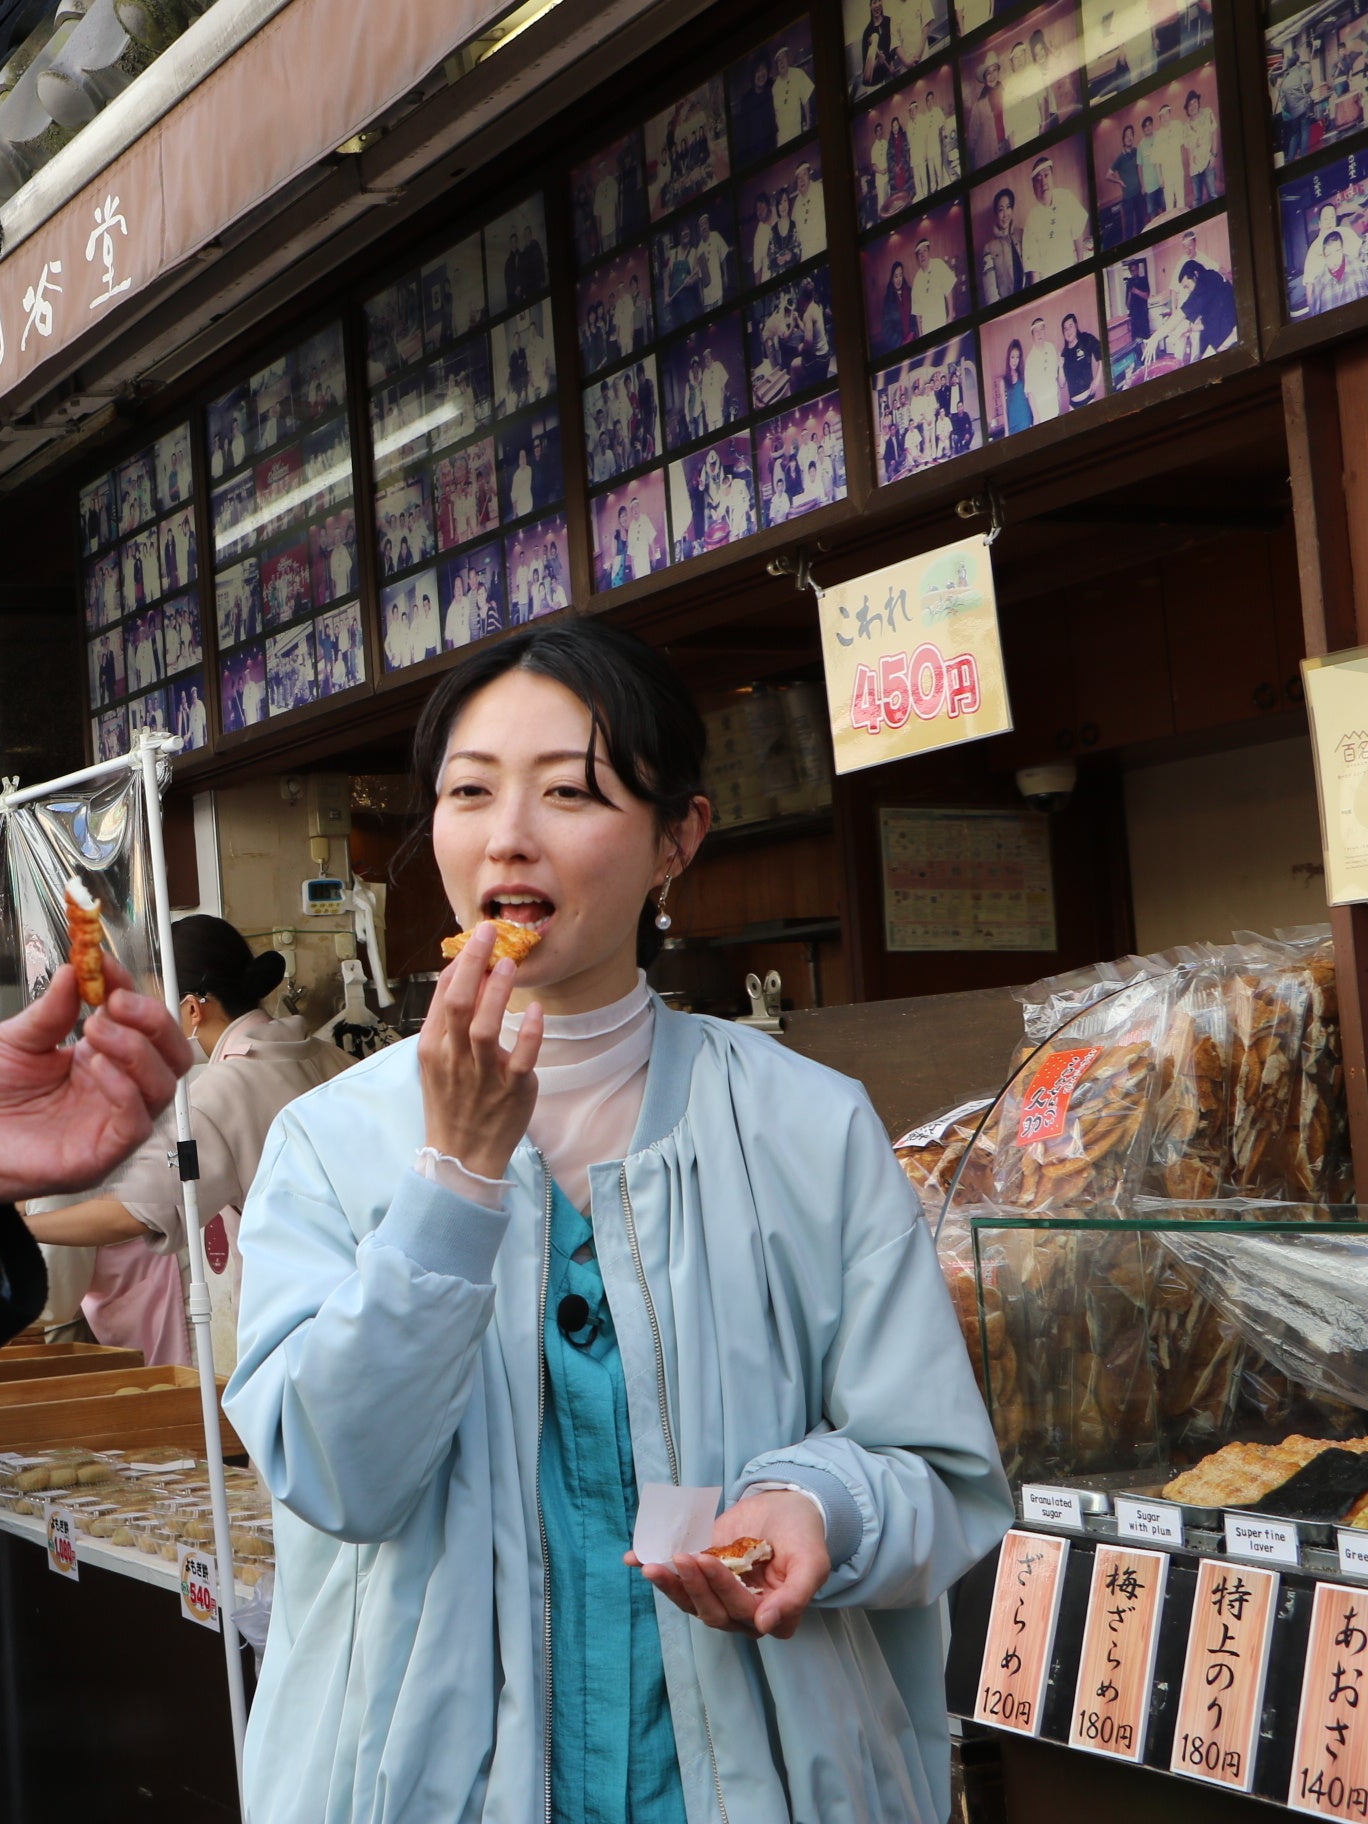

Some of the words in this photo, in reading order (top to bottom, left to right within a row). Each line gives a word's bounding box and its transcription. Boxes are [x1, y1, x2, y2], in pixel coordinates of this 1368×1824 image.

[836, 586, 913, 647] こわれ
[851, 642, 981, 735] 450円
[1030, 1493, 1073, 1508] Granulated
[1042, 1508, 1063, 1520] sugar
[1136, 1509, 1161, 1523] Sugar
[1129, 1522, 1148, 1532] with
[1152, 1524, 1172, 1536] plum
[1249, 1540, 1274, 1553] laver
[1000, 1552, 1043, 1677] ざらめ
[1096, 1563, 1145, 1704] 梅ざらめ
[1205, 1575, 1252, 1731] 特上のり
[983, 1686, 1032, 1725] 120円
[1325, 1606, 1368, 1764] あおさ
[1079, 1709, 1133, 1749] 180円
[1182, 1733, 1241, 1778] 180円
[1300, 1768, 1368, 1817] 140円
